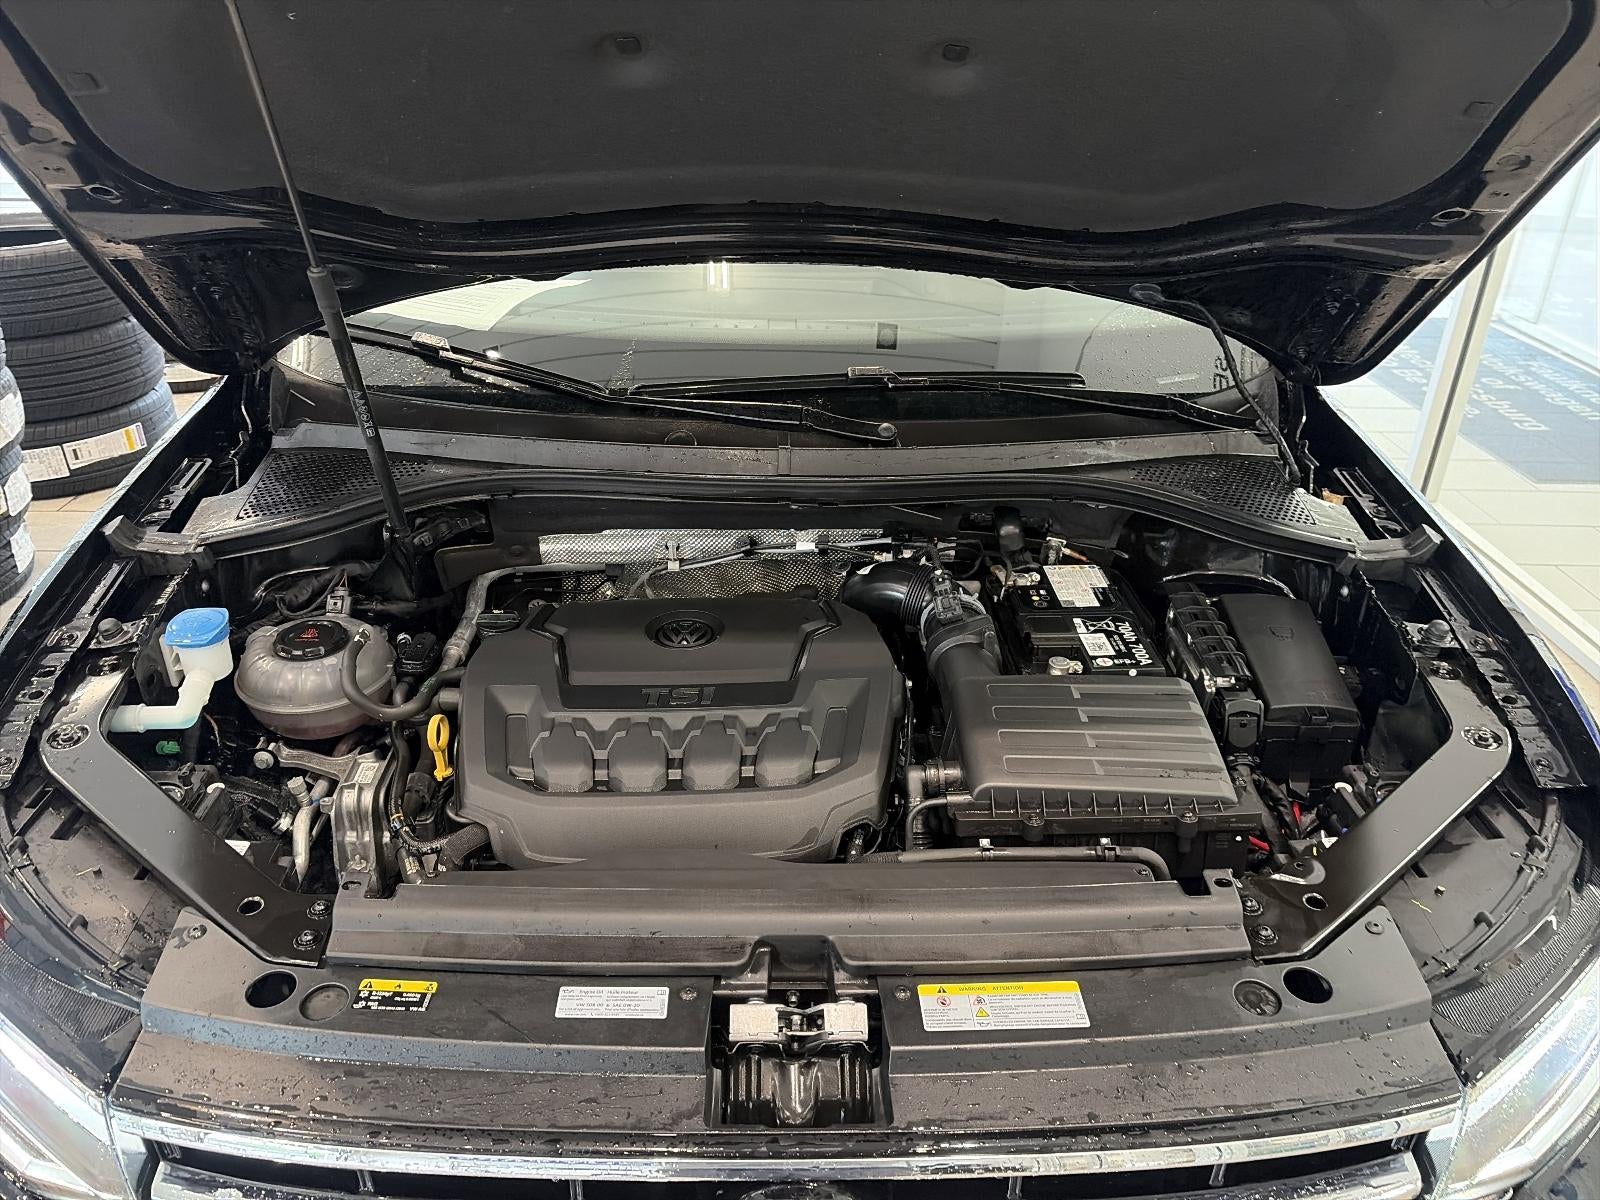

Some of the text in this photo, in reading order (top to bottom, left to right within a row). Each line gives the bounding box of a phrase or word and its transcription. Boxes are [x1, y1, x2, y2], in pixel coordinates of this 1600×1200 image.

[1480, 378, 1523, 389] of
[1115, 621, 1138, 642] 70Ah
[1128, 643, 1153, 666] 700A
[641, 686, 716, 706] TSI
